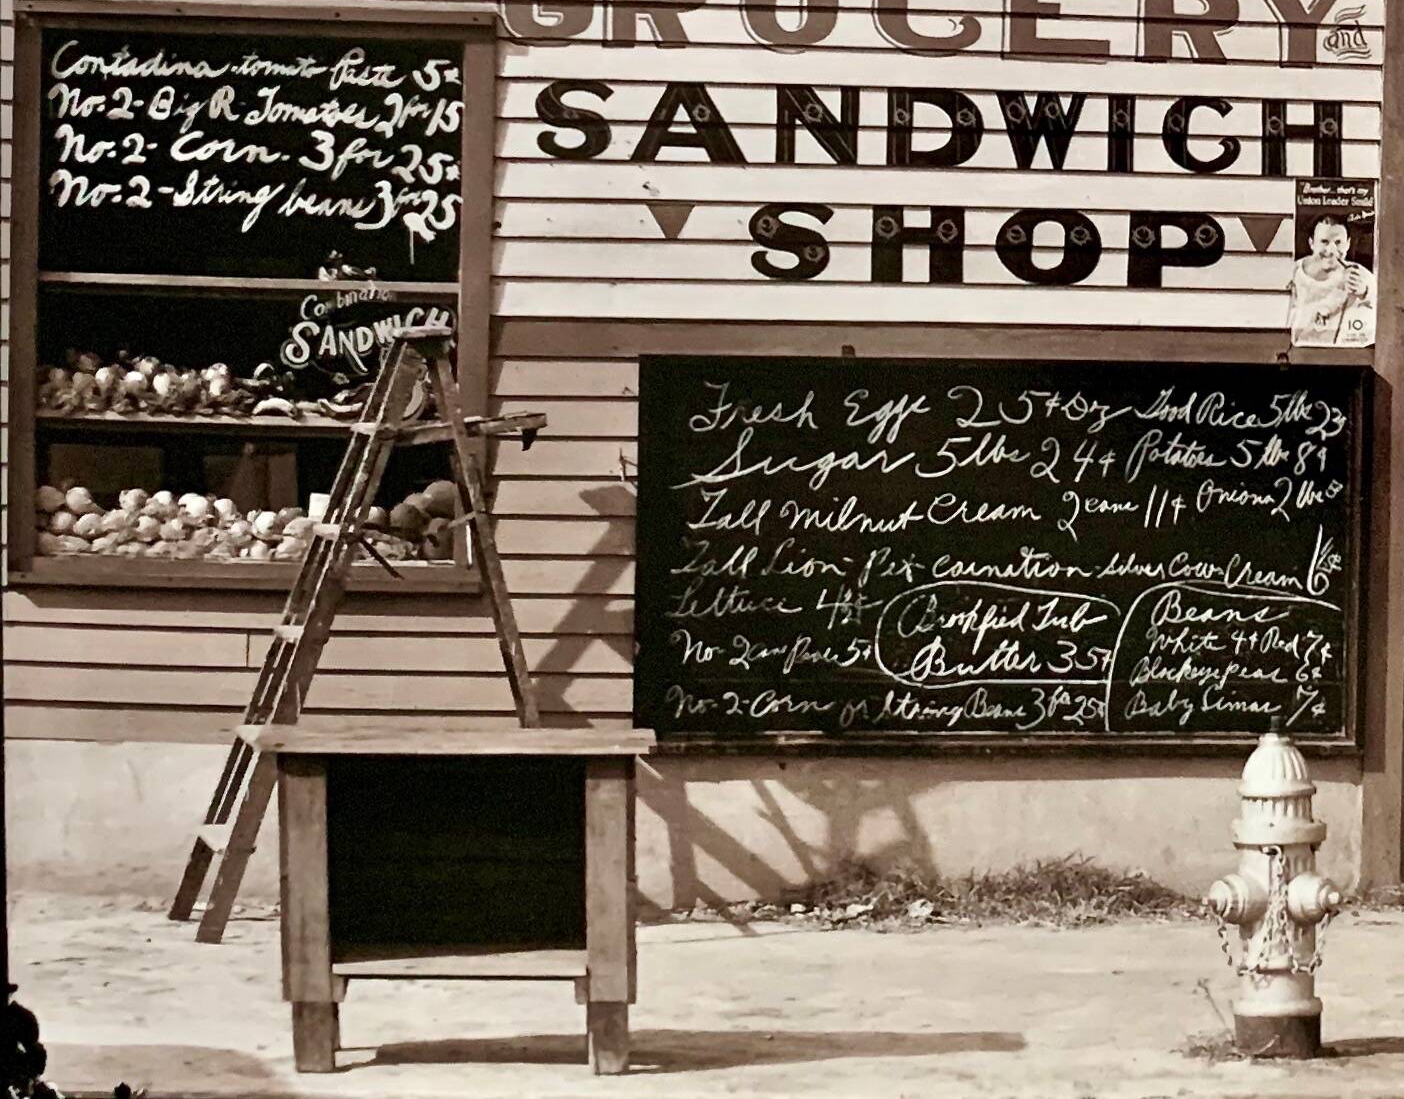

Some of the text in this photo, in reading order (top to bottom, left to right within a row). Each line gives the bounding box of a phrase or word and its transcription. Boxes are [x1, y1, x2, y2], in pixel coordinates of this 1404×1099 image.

[1322, 17, 1369, 52] and
[52, 40, 231, 80] Contadina
[148, 85, 209, 134] Big
[244, 85, 381, 129] Tomatoes
[535, 79, 1344, 178] SANDWICH
[299, 130, 336, 171] 3
[331, 137, 395, 181] for
[277, 177, 376, 219] beans
[748, 201, 1227, 289] SHOP
[689, 381, 819, 432] Fresh
[1133, 385, 1193, 424] Good
[1195, 391, 1260, 429] Rice
[668, 427, 917, 491] Sugar
[1125, 428, 1228, 484] Potatoes
[685, 487, 772, 536] Tall
[926, 492, 1043, 525] Cream
[1196, 478, 1277, 514] Onions
[1224, 552, 1304, 589] Cream
[664, 578, 803, 618] Lettuce
[1150, 588, 1291, 626] Beans
[910, 634, 1042, 682] Butter
[1145, 626, 1227, 655] White
[1124, 689, 1195, 727] Baby
